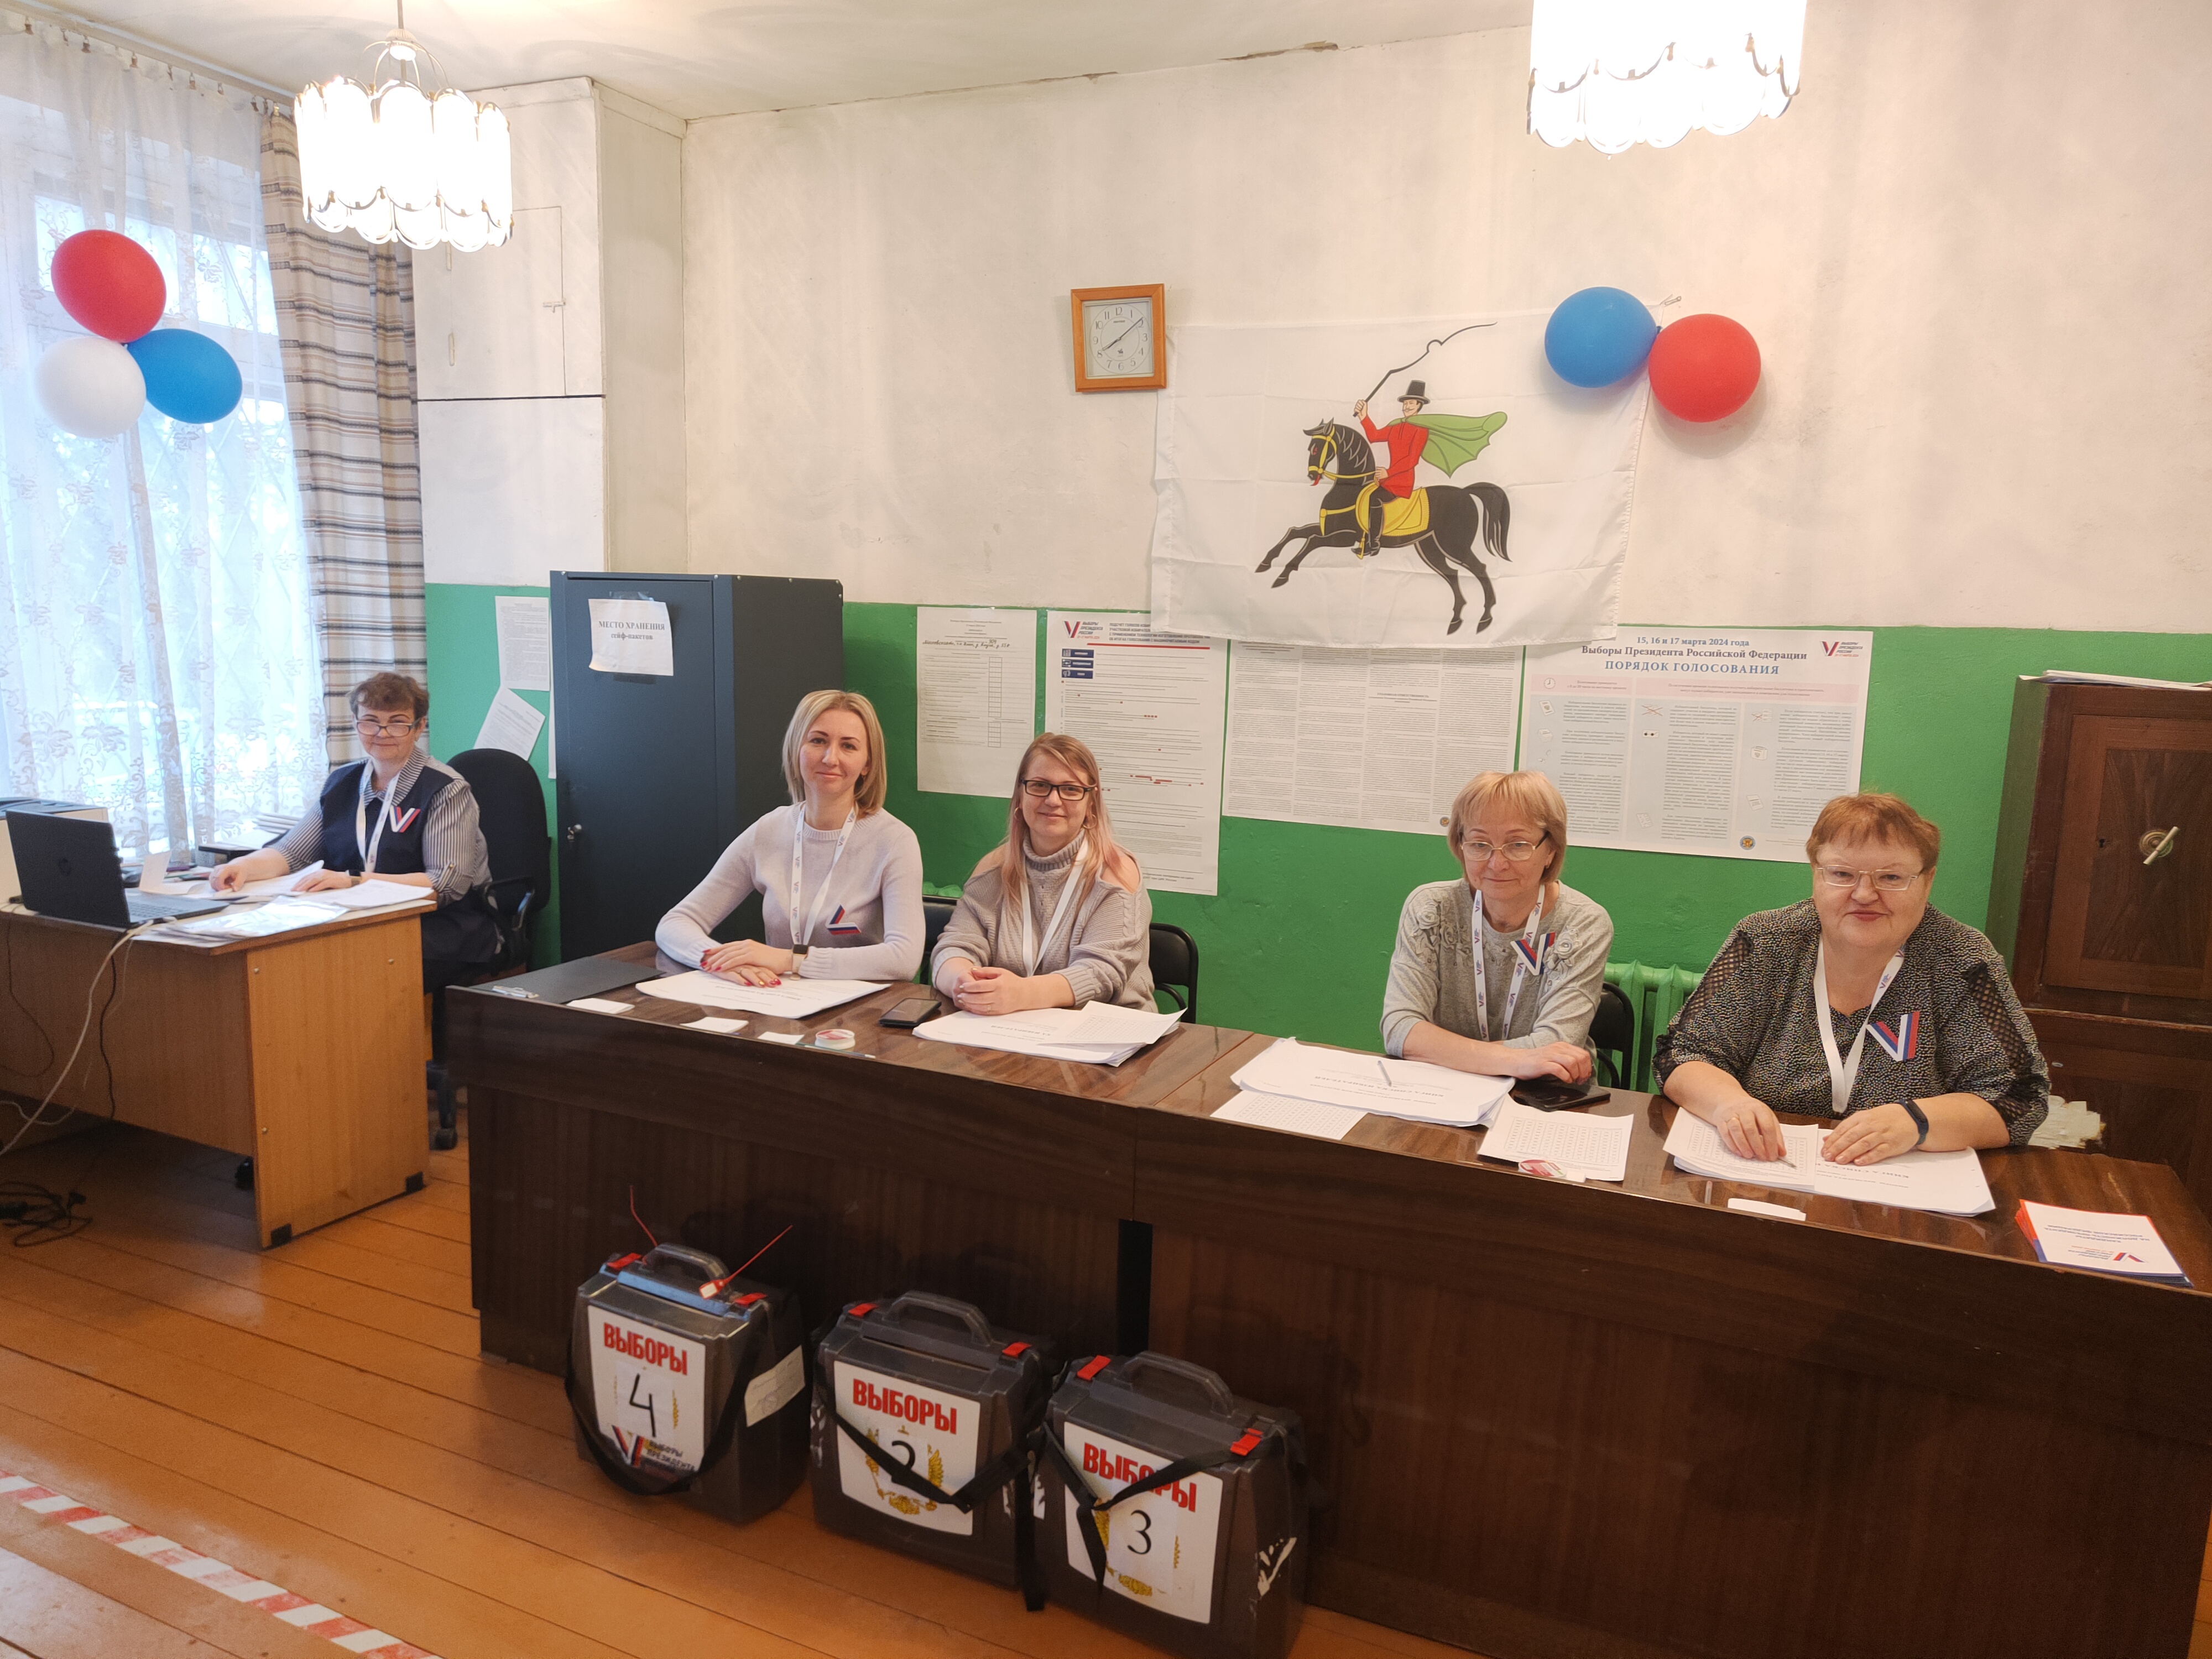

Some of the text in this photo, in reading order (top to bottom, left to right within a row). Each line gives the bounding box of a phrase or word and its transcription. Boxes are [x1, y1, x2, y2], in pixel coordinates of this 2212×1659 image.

[1104, 311, 1110, 320] 11
[1115, 306, 1123, 316] 12
[1095, 321, 1103, 330] 10
[1093, 336, 1099, 345] 9
[1142, 333, 1148, 342] 3
[1097, 349, 1103, 358] 8
[1138, 347, 1144, 356] 4
[1107, 359, 1113, 369] 7
[1118, 362, 1124, 371] 6
[1130, 358, 1136, 367] 5
[598, 620, 665, 630] МЕСТО ХРАНЕНИЯ
[611, 632, 654, 640] сейф-пакетов
[1637, 637, 1648, 645] 15,
[1582, 645, 1808, 661] Выборы Президента Российской Федерации
[1605, 661, 1780, 675] ПОРЯДОК ГОЛОСОВАНИЯ
[603, 1322, 687, 1376] ВЫБОРЫ
[629, 1373, 656, 1438] 4
[853, 1378, 957, 1435] ВЫБОРЫ
[1127, 1509, 1152, 1555] 3
